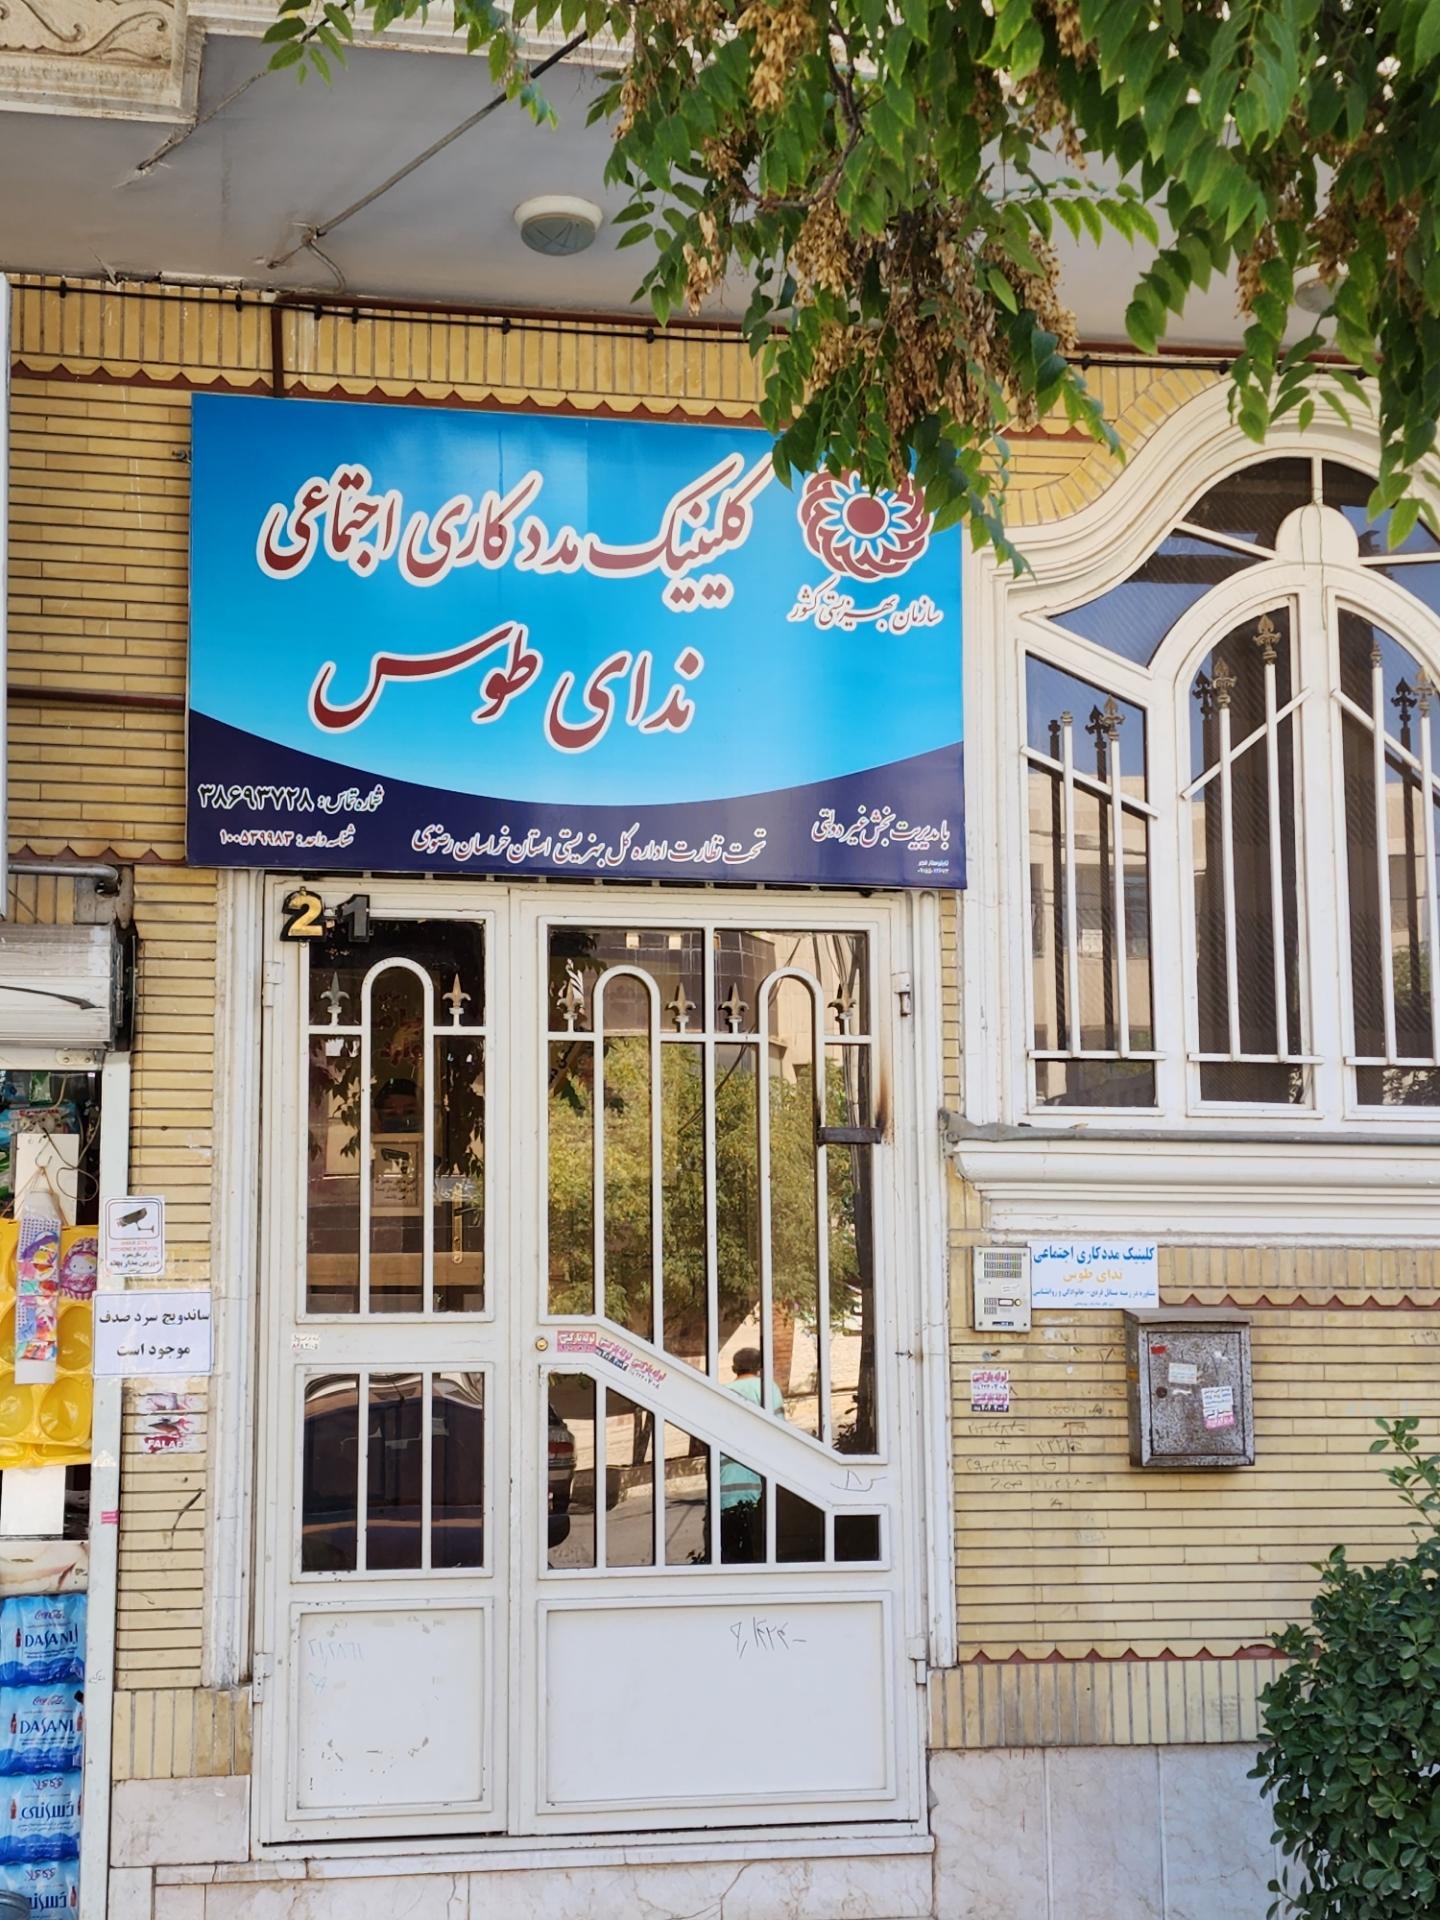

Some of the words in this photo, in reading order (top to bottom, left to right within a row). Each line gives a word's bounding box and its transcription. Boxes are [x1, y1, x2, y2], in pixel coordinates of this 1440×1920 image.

[260, 467, 399, 576] اجتماعی
[586, 456, 775, 608] کلینیک
[786, 575, 840, 622] کشور
[815, 591, 899, 632] بهزیستی
[889, 595, 944, 634] سازمان
[311, 622, 541, 731] طوس
[547, 650, 702, 751] ندای
[197, 784, 315, 812] ۳۸۶۹۳۷۲۸
[355, 784, 384, 812] شماره
[325, 823, 356, 847] شناسه
[411, 824, 454, 854] رضوی
[811, 808, 844, 842] دولتی
[838, 805, 870, 845] غیر
[860, 806, 896, 848] بخش
[890, 821, 940, 850] مدیریت
[940, 820, 950, 850] با
[452, 825, 511, 862] خراسان
[507, 829, 552, 864] استان
[552, 827, 606, 867] بهزیستی
[605, 822, 640, 866] کل
[632, 840, 667, 862] اداره
[667, 835, 722, 863] نظارت
[722, 828, 767, 864] تحت
[1033, 1245, 1073, 1263] اجتماعی
[1123, 1246, 1155, 1264] کلینیک
[1064, 1268, 1093, 1282] طوس
[1096, 1269, 1122, 1283] ندای
[99, 1310, 131, 1323] صدف
[134, 1313, 158, 1326] سرد
[117, 1344, 144, 1356] است
[149, 1345, 190, 1360] موجود
[25, 1630, 73, 1649] DASANI
[20, 1717, 74, 1736] DASANI
